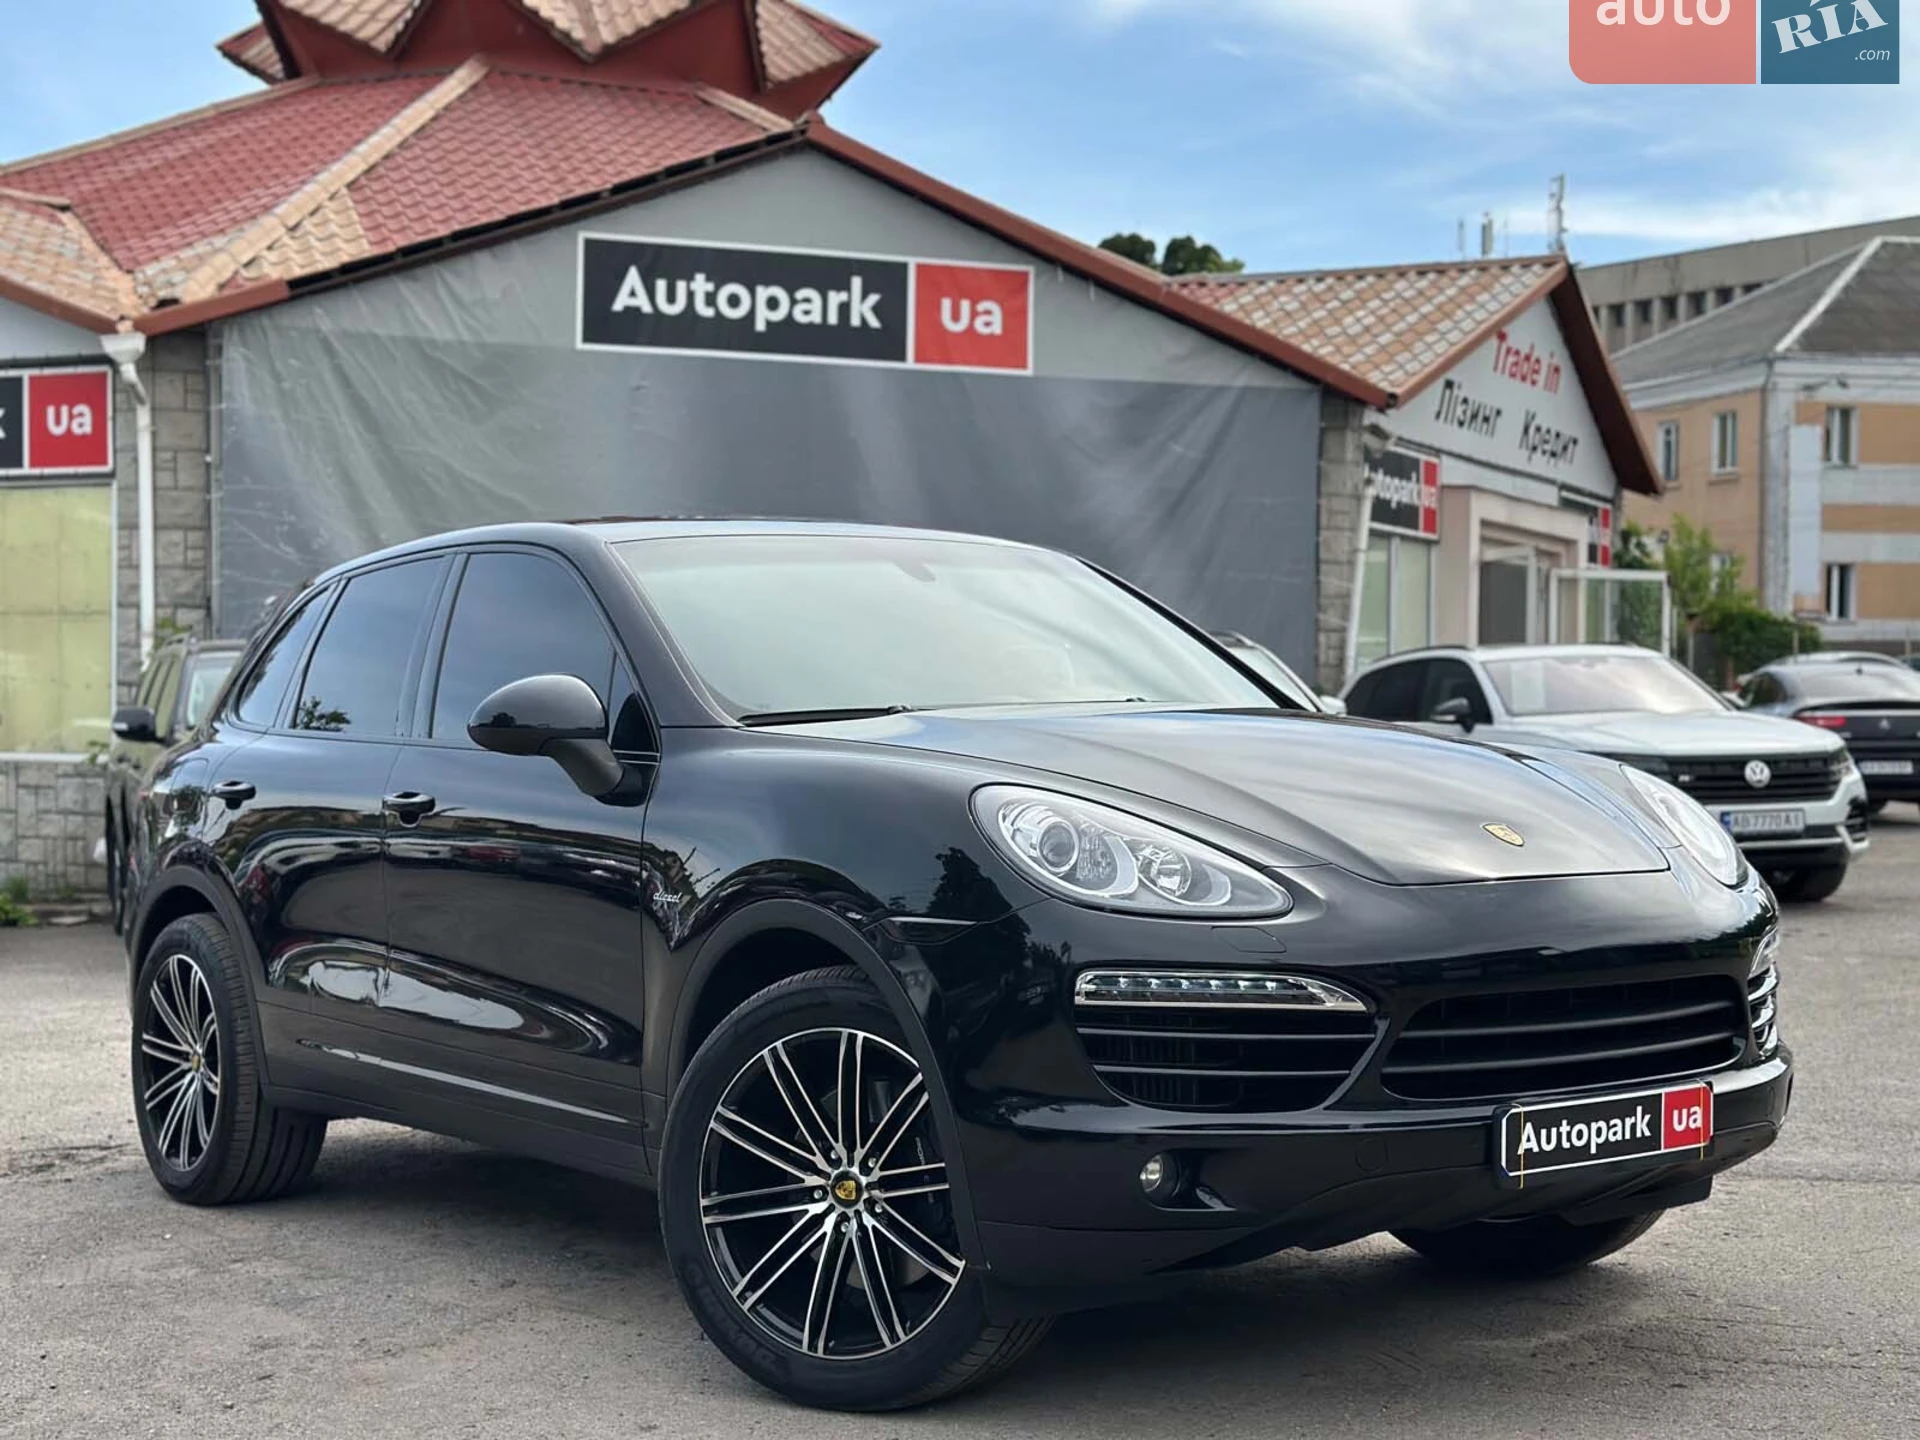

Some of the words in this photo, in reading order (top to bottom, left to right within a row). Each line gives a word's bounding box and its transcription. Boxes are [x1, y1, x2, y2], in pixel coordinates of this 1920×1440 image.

[611, 265, 882, 332] Autopark
[940, 296, 1003, 335] ua
[1493, 331, 1542, 387] Trade
[1543, 352, 1561, 394] in
[45, 403, 93, 437] ua
[1518, 408, 1579, 470] Кредит
[1517, 1105, 1651, 1155] Autopark
[1672, 1104, 1702, 1132] ua
